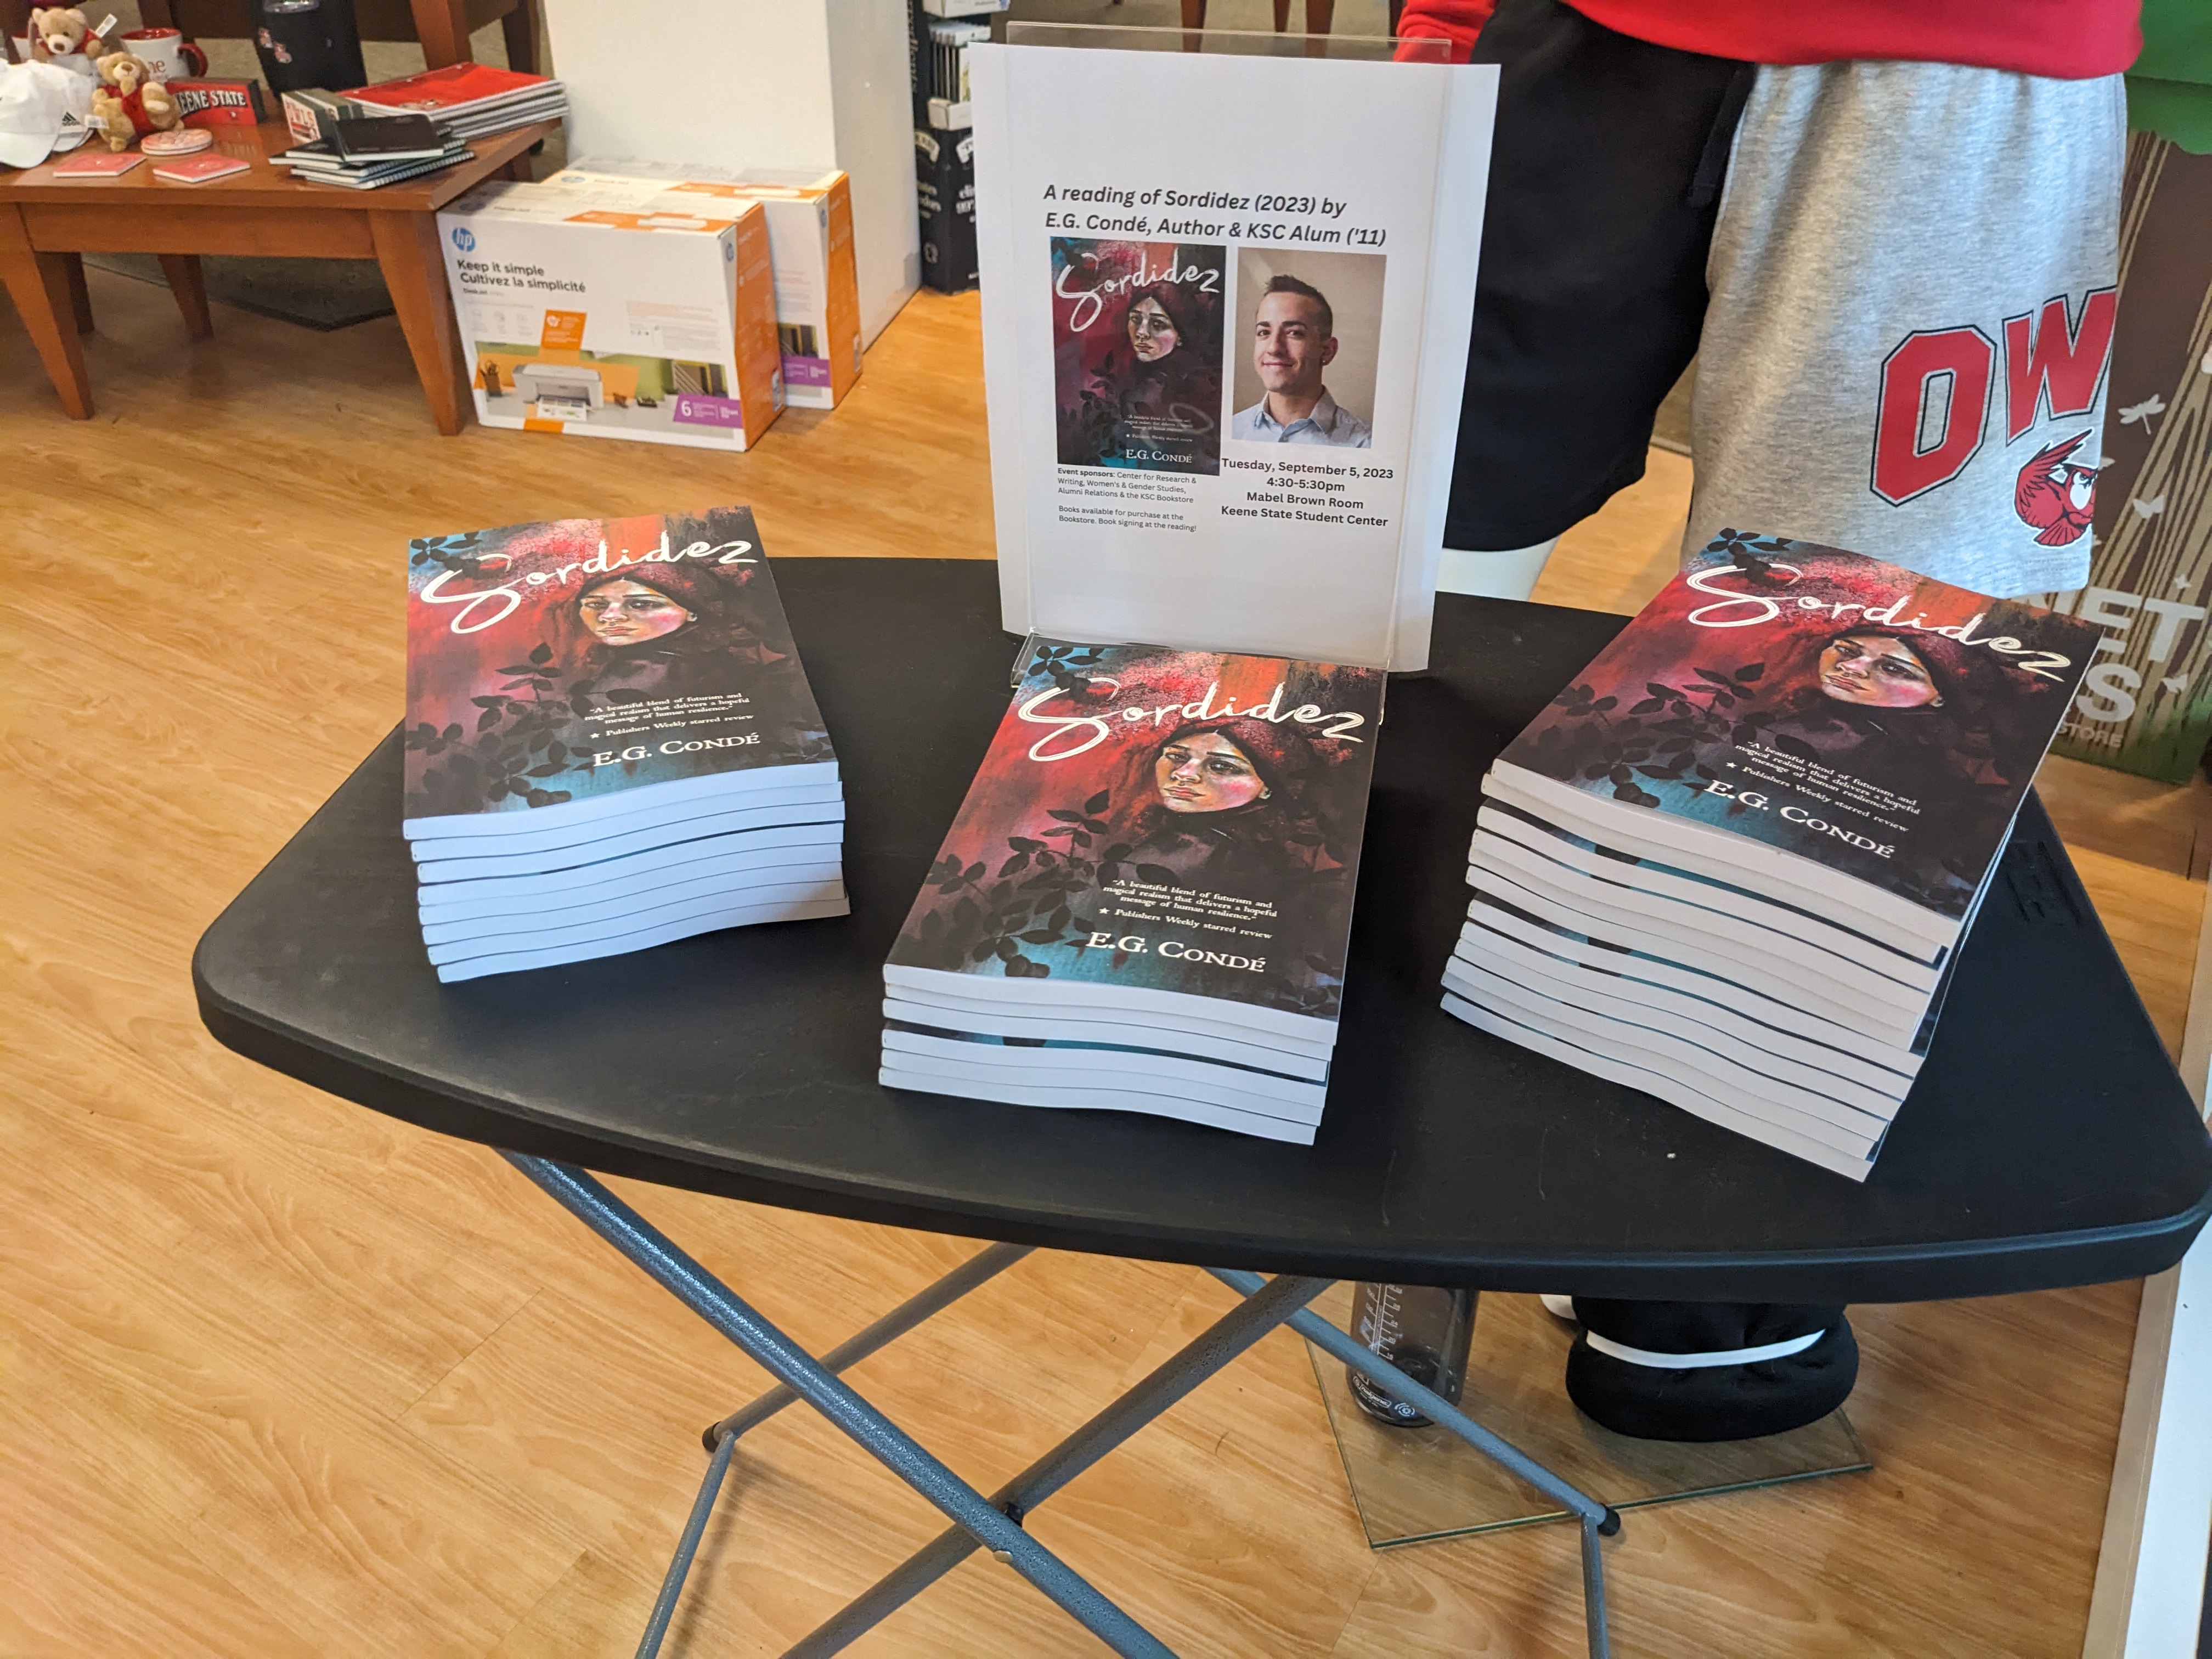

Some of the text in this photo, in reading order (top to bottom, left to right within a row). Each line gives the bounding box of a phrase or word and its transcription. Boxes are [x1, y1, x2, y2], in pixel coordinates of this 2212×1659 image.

[210, 89, 246, 106] STATE
[1044, 185, 1346, 218] A reading of Sordidez (2023) by
[455, 228, 474, 252] hp
[1046, 213, 1386, 247] E.G. Condé, Author & KSC Alum ('11)
[457, 259, 545, 276] Keep it simple
[460, 273, 586, 292] Cultivez la simplicité
[1056, 246, 1220, 331] Sordidez
[682, 400, 691, 416] 6
[1126, 449, 1149, 460] E.G.
[1080, 470, 1115, 479] sponsors:
[1156, 475, 1189, 484] Research
[1222, 458, 1393, 478] Tuesday, September 5, 2023
[1058, 478, 1085, 487] Writing,
[1157, 484, 1186, 494] Studies,
[1267, 478, 1345, 492] 4:30-5:30pm
[1157, 494, 1193, 503] Bookstore
[1247, 492, 1363, 509] Mabel Brown Room
[1081, 507, 1113, 516] available
[1128, 510, 1160, 520] purchase
[1221, 506, 1388, 526] Keene State Student Center
[1059, 516, 1096, 524] Bookstore.
[1119, 520, 1143, 528] signing
[1167, 523, 1197, 532] reading!
[420, 531, 758, 634] Sordidez
[1687, 563, 2071, 682] Sordidez
[584, 712, 616, 721] magical
[619, 708, 649, 716] realism
[719, 698, 750, 707] hopeful
[607, 702, 643, 712] beautiful
[605, 716, 639, 724] message
[606, 726, 650, 736] Publishers
[654, 721, 686, 730] Weekly
[1018, 677, 1364, 761] Sordidez
[593, 746, 652, 767] E.G.
[1735, 744, 1769, 759] magical
[1773, 757, 1807, 771] realism
[1810, 770, 1829, 780] that
[1832, 777, 1870, 795] delivers
[1883, 797, 1920, 815] hopeful
[1751, 757, 1788, 773] message
[1808, 775, 1839, 792] human
[1765, 746, 1804, 764] beautiful
[1808, 761, 1836, 775] blend
[1853, 778, 1894, 798] futurism
[1898, 794, 1917, 806] and
[1704, 780, 1769, 810] E.G.
[1742, 766, 1909, 832] Publishers Weekly starred review
[1103, 887, 1135, 895] magical
[1139, 891, 1171, 900] realism
[1196, 899, 1231, 909] delivers
[1244, 906, 1277, 917] hopeful
[1130, 881, 1167, 892] beautiful
[1171, 887, 1195, 896] blend
[1214, 894, 1252, 905] futurism
[1120, 896, 1156, 906] message
[1174, 902, 1204, 913] human
[1115, 909, 1272, 939] Publishers Weekly starred review
[1086, 932, 1148, 953] E.G.
